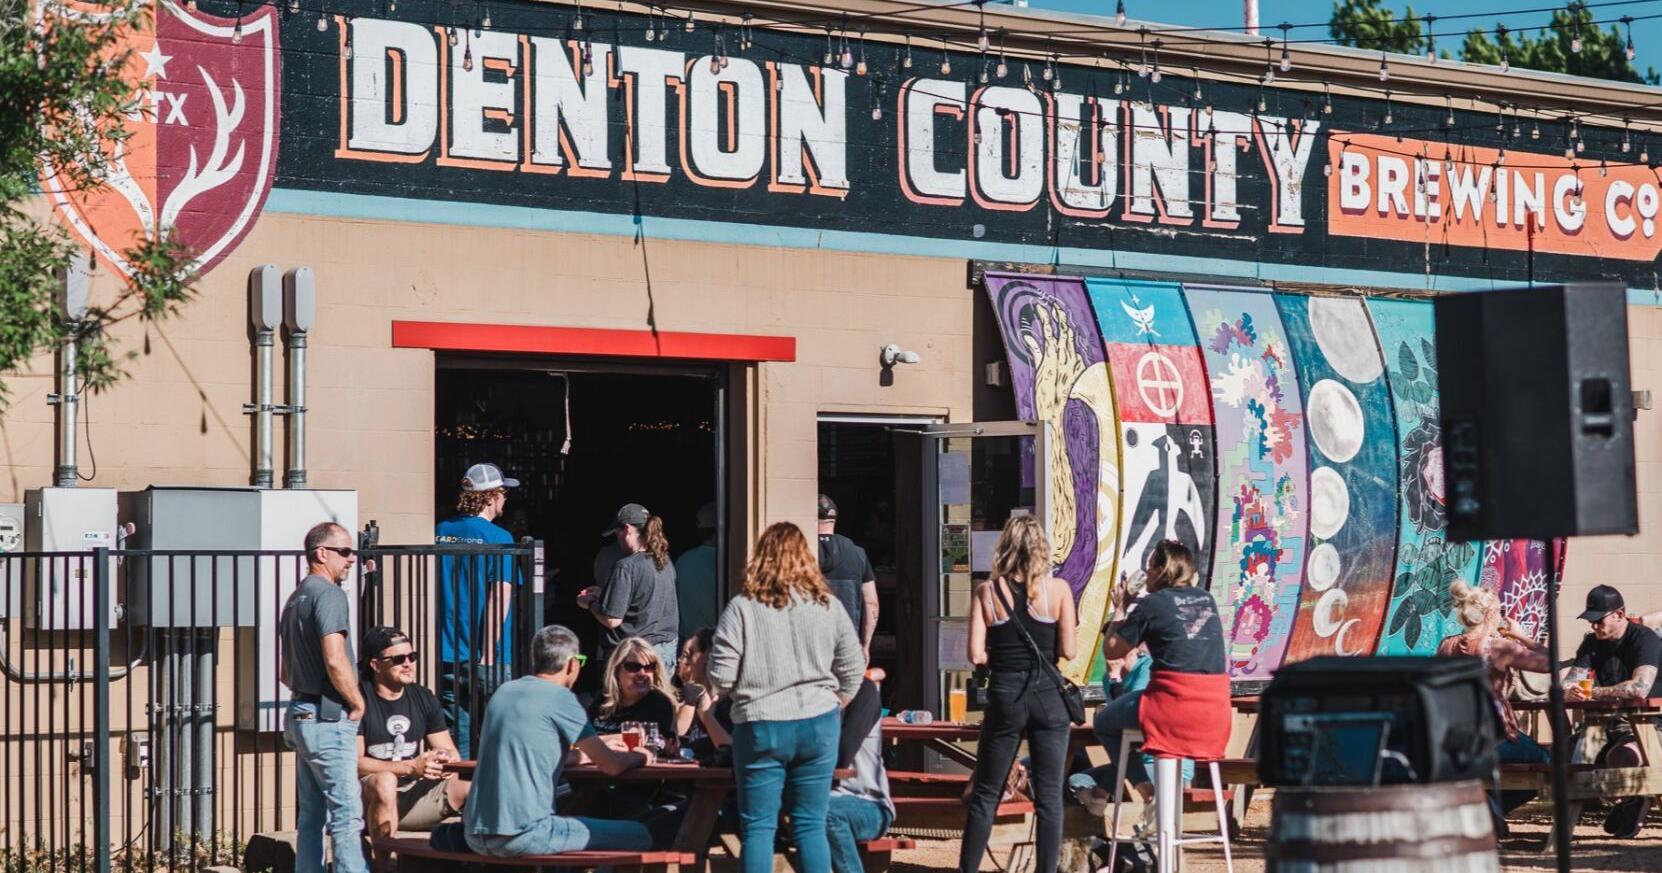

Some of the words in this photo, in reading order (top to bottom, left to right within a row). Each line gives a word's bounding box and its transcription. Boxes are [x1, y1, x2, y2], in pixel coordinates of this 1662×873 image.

[335, 16, 851, 199] DENTON
[898, 77, 1321, 234] COUNTY
[1339, 151, 1588, 236] BREWING
